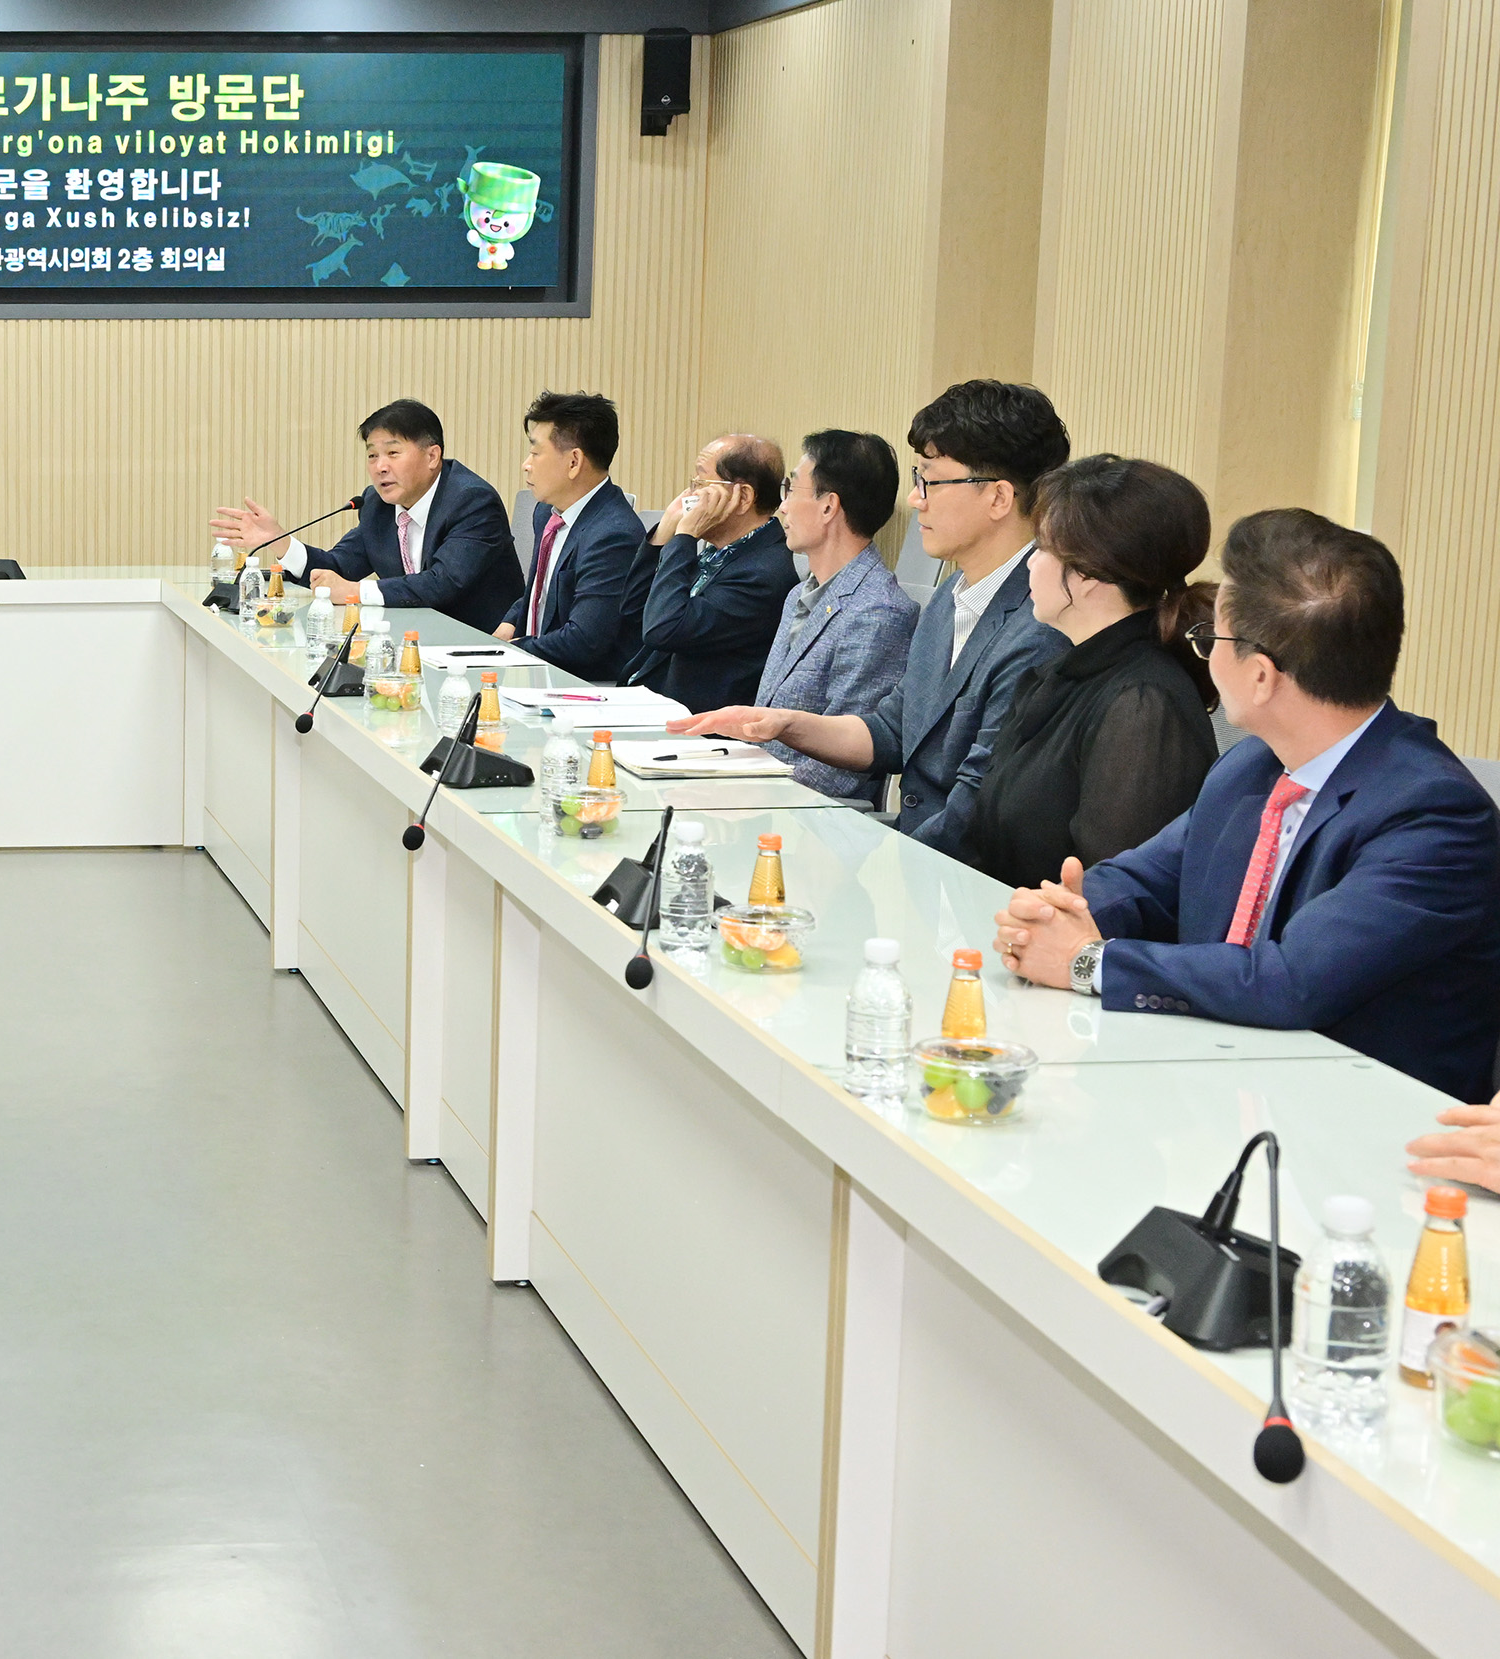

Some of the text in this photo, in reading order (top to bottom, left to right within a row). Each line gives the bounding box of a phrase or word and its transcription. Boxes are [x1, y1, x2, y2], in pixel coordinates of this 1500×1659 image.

[168, 72, 306, 123] 방문단
[113, 128, 228, 159] viloyat
[239, 128, 395, 159] Hokimligi
[63, 167, 223, 202] 환영합니다
[45, 205, 116, 229] Xush
[125, 205, 251, 229] kelibsiz!
[116, 246, 155, 273] 2층
[159, 246, 226, 273] 회의실
